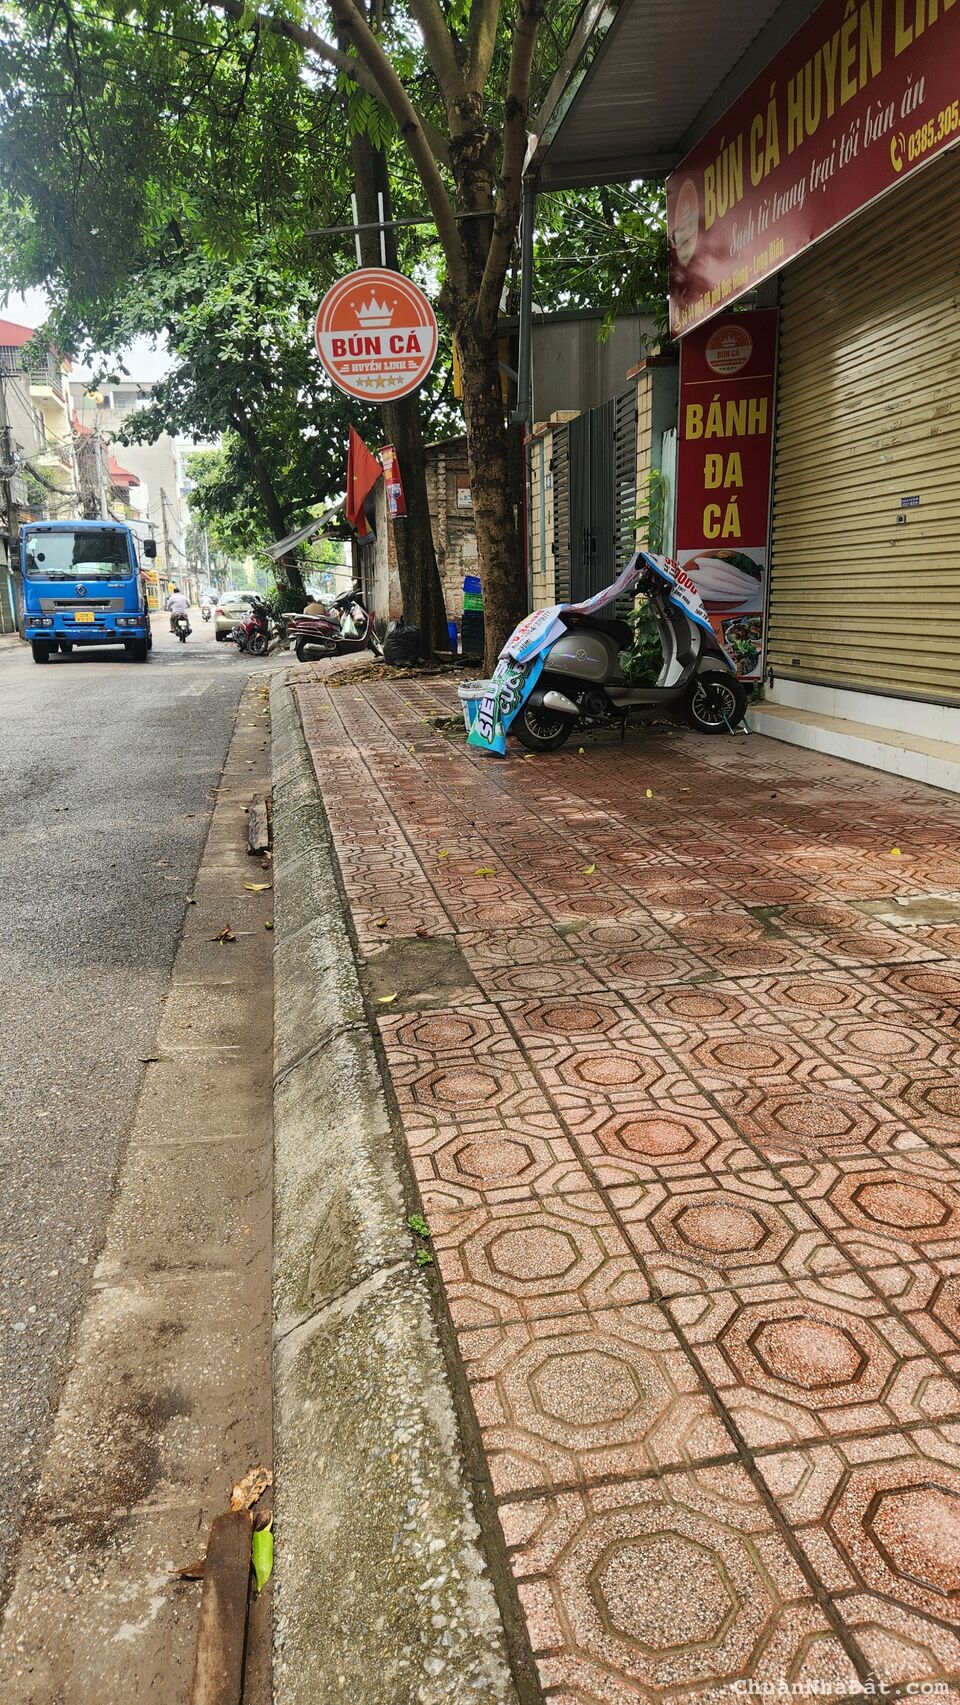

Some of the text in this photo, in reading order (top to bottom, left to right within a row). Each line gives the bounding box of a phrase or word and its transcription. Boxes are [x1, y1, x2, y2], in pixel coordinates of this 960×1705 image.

[703, 132, 744, 231] BÚN
[750, 83, 780, 187] CÁ
[730, 208, 755, 258] Sạch
[758, 200, 770, 235] từ
[772, 176, 807, 222] trang
[810, 139, 836, 193] trại
[839, 118, 861, 169] tới
[864, 99, 897, 150] bàn
[901, 72, 927, 119] ăn
[331, 330, 422, 358] BÚN CÁ
[384, 361, 407, 371] LINH
[685, 394, 768, 441] BÁNH
[703, 451, 744, 490] ĐA
[702, 496, 742, 539] CÁ
